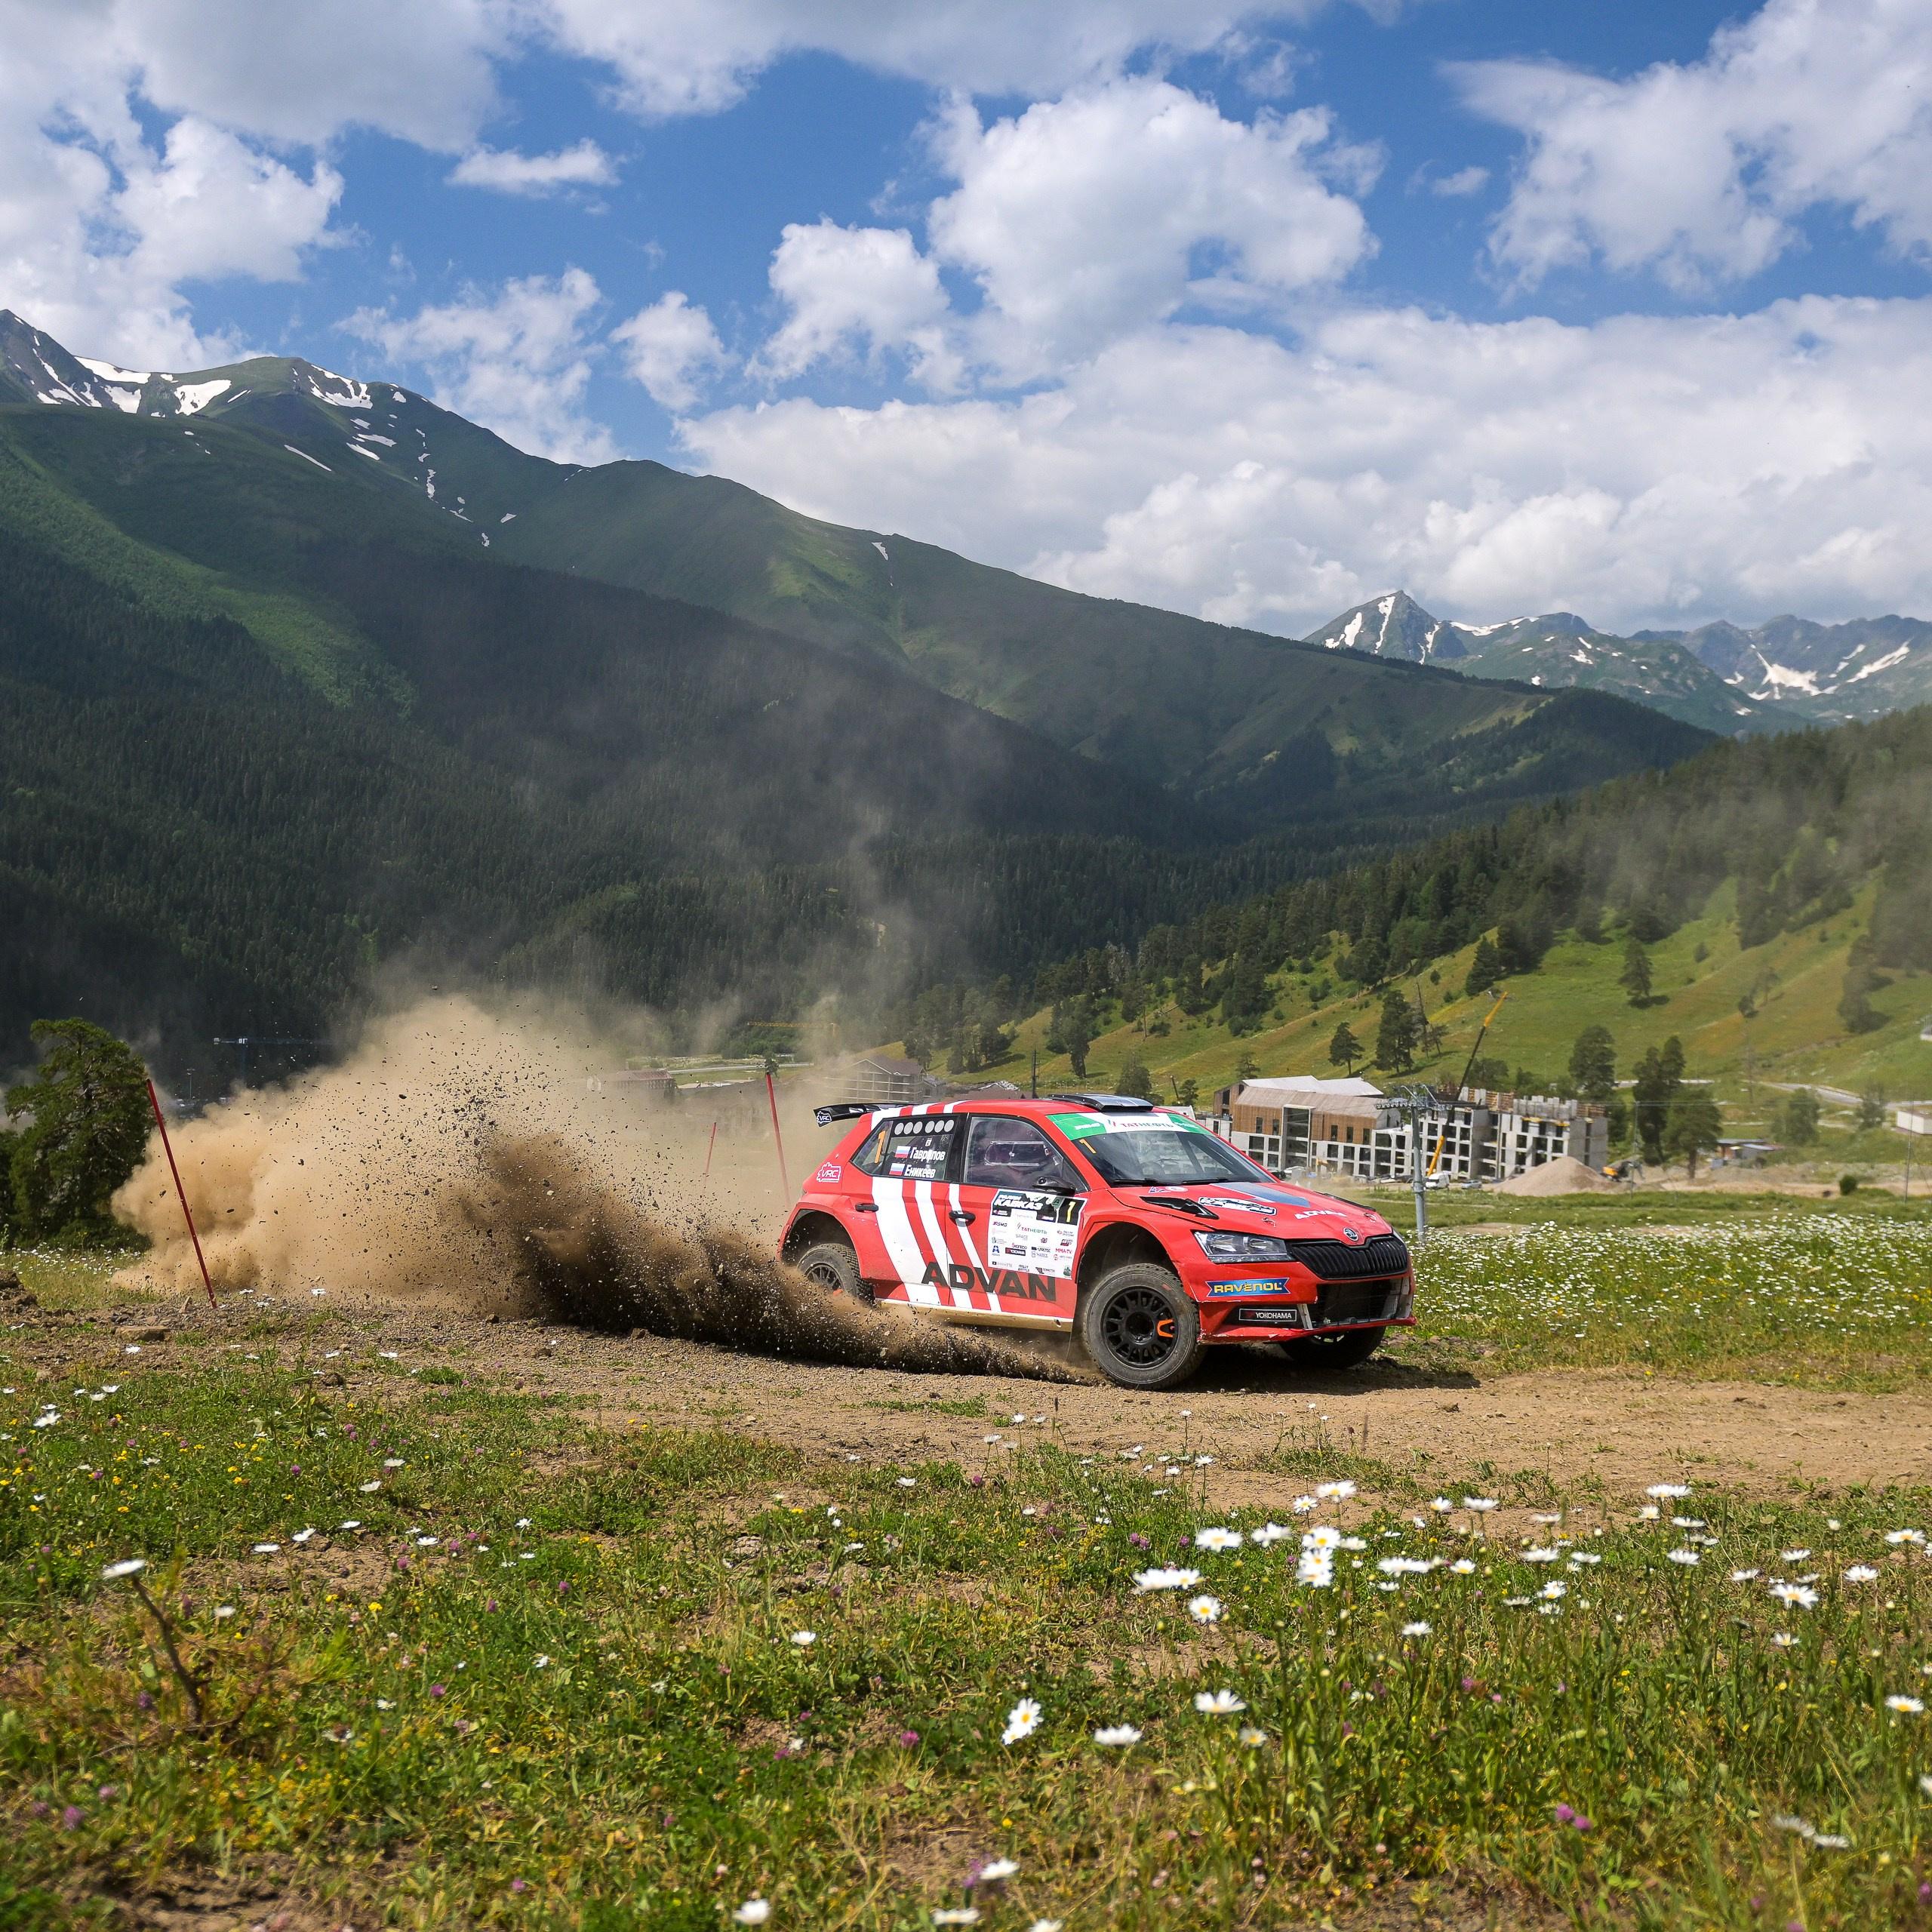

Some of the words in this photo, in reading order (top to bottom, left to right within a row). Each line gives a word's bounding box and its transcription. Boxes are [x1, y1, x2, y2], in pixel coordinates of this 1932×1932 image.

[875, 1131, 886, 1163] 1
[1078, 1139, 1097, 1154] 1
[822, 1169, 839, 1178] VRC
[994, 1198, 1044, 1211] КАВКАЗ
[1066, 1201, 1076, 1223] 1
[921, 1261, 1056, 1302] ADVAN
[1214, 1282, 1282, 1294] RAVENOL
